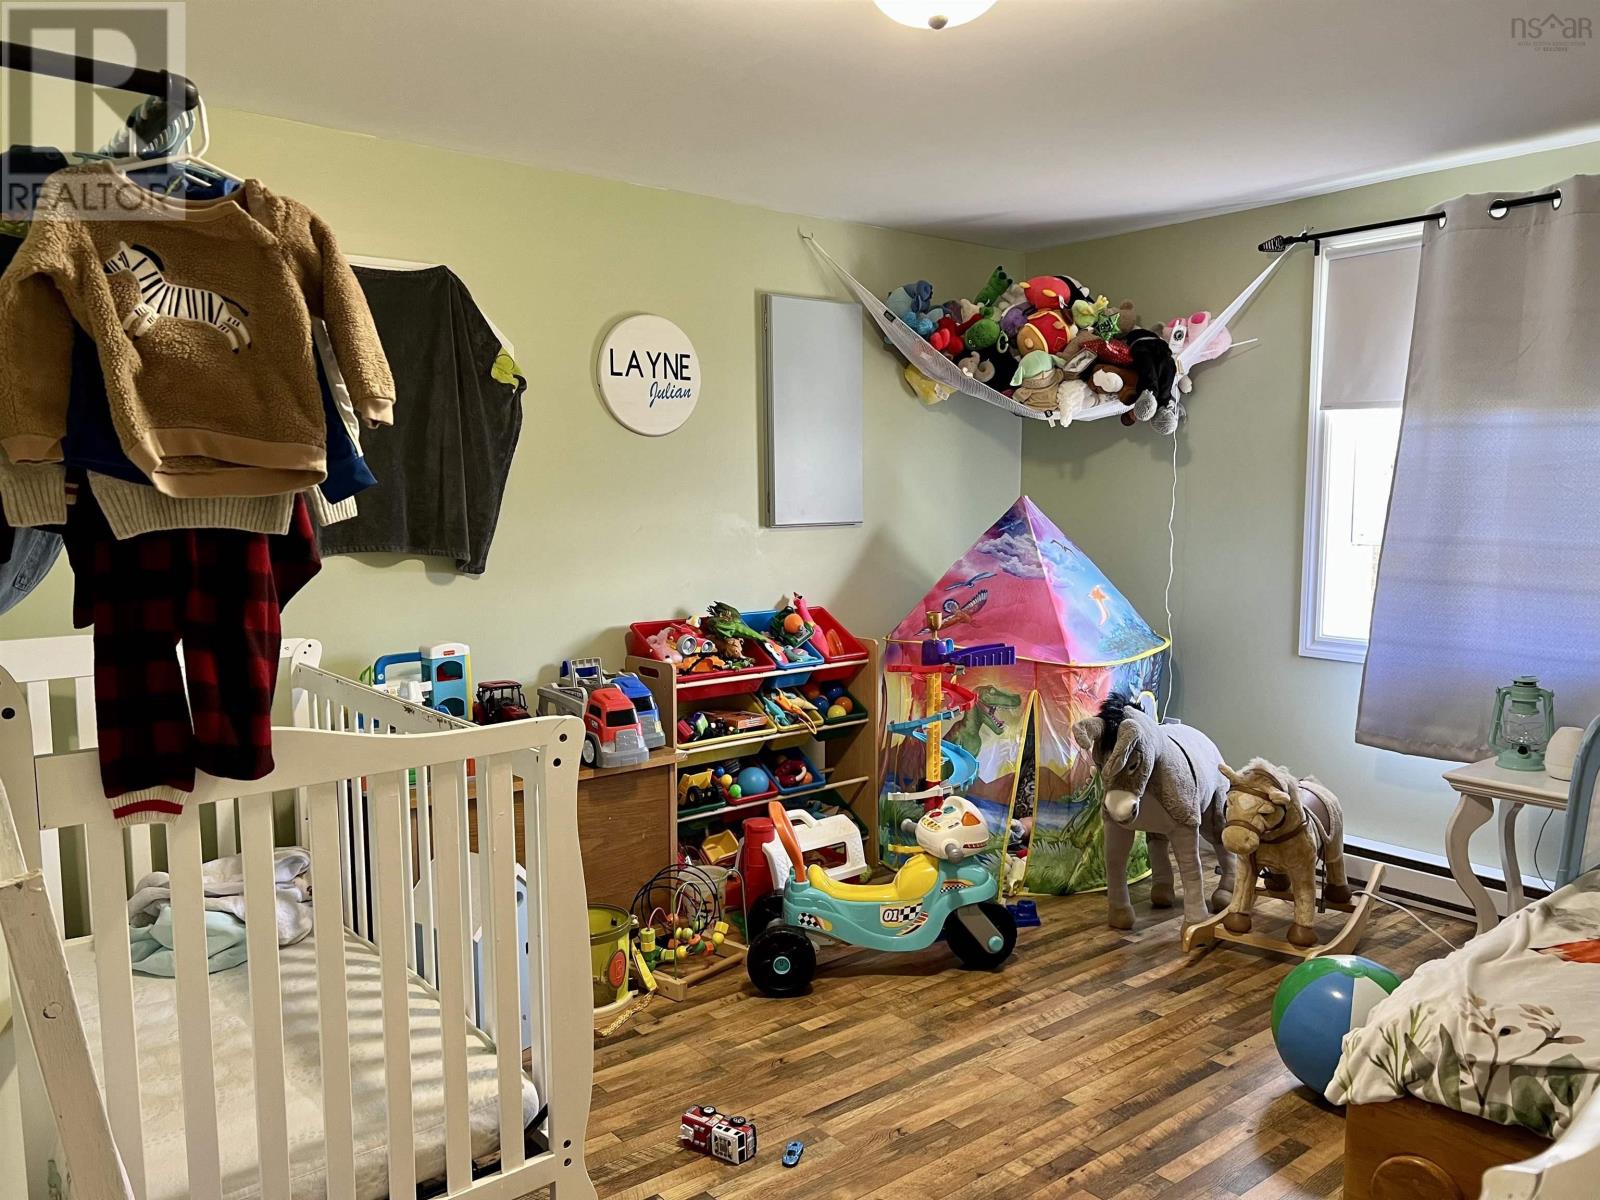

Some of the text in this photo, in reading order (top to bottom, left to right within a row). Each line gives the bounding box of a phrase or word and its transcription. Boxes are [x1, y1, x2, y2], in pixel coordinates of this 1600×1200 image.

[609, 348, 691, 381] LAYNE
[649, 381, 691, 408] Julian
[883, 909, 899, 922] 01
